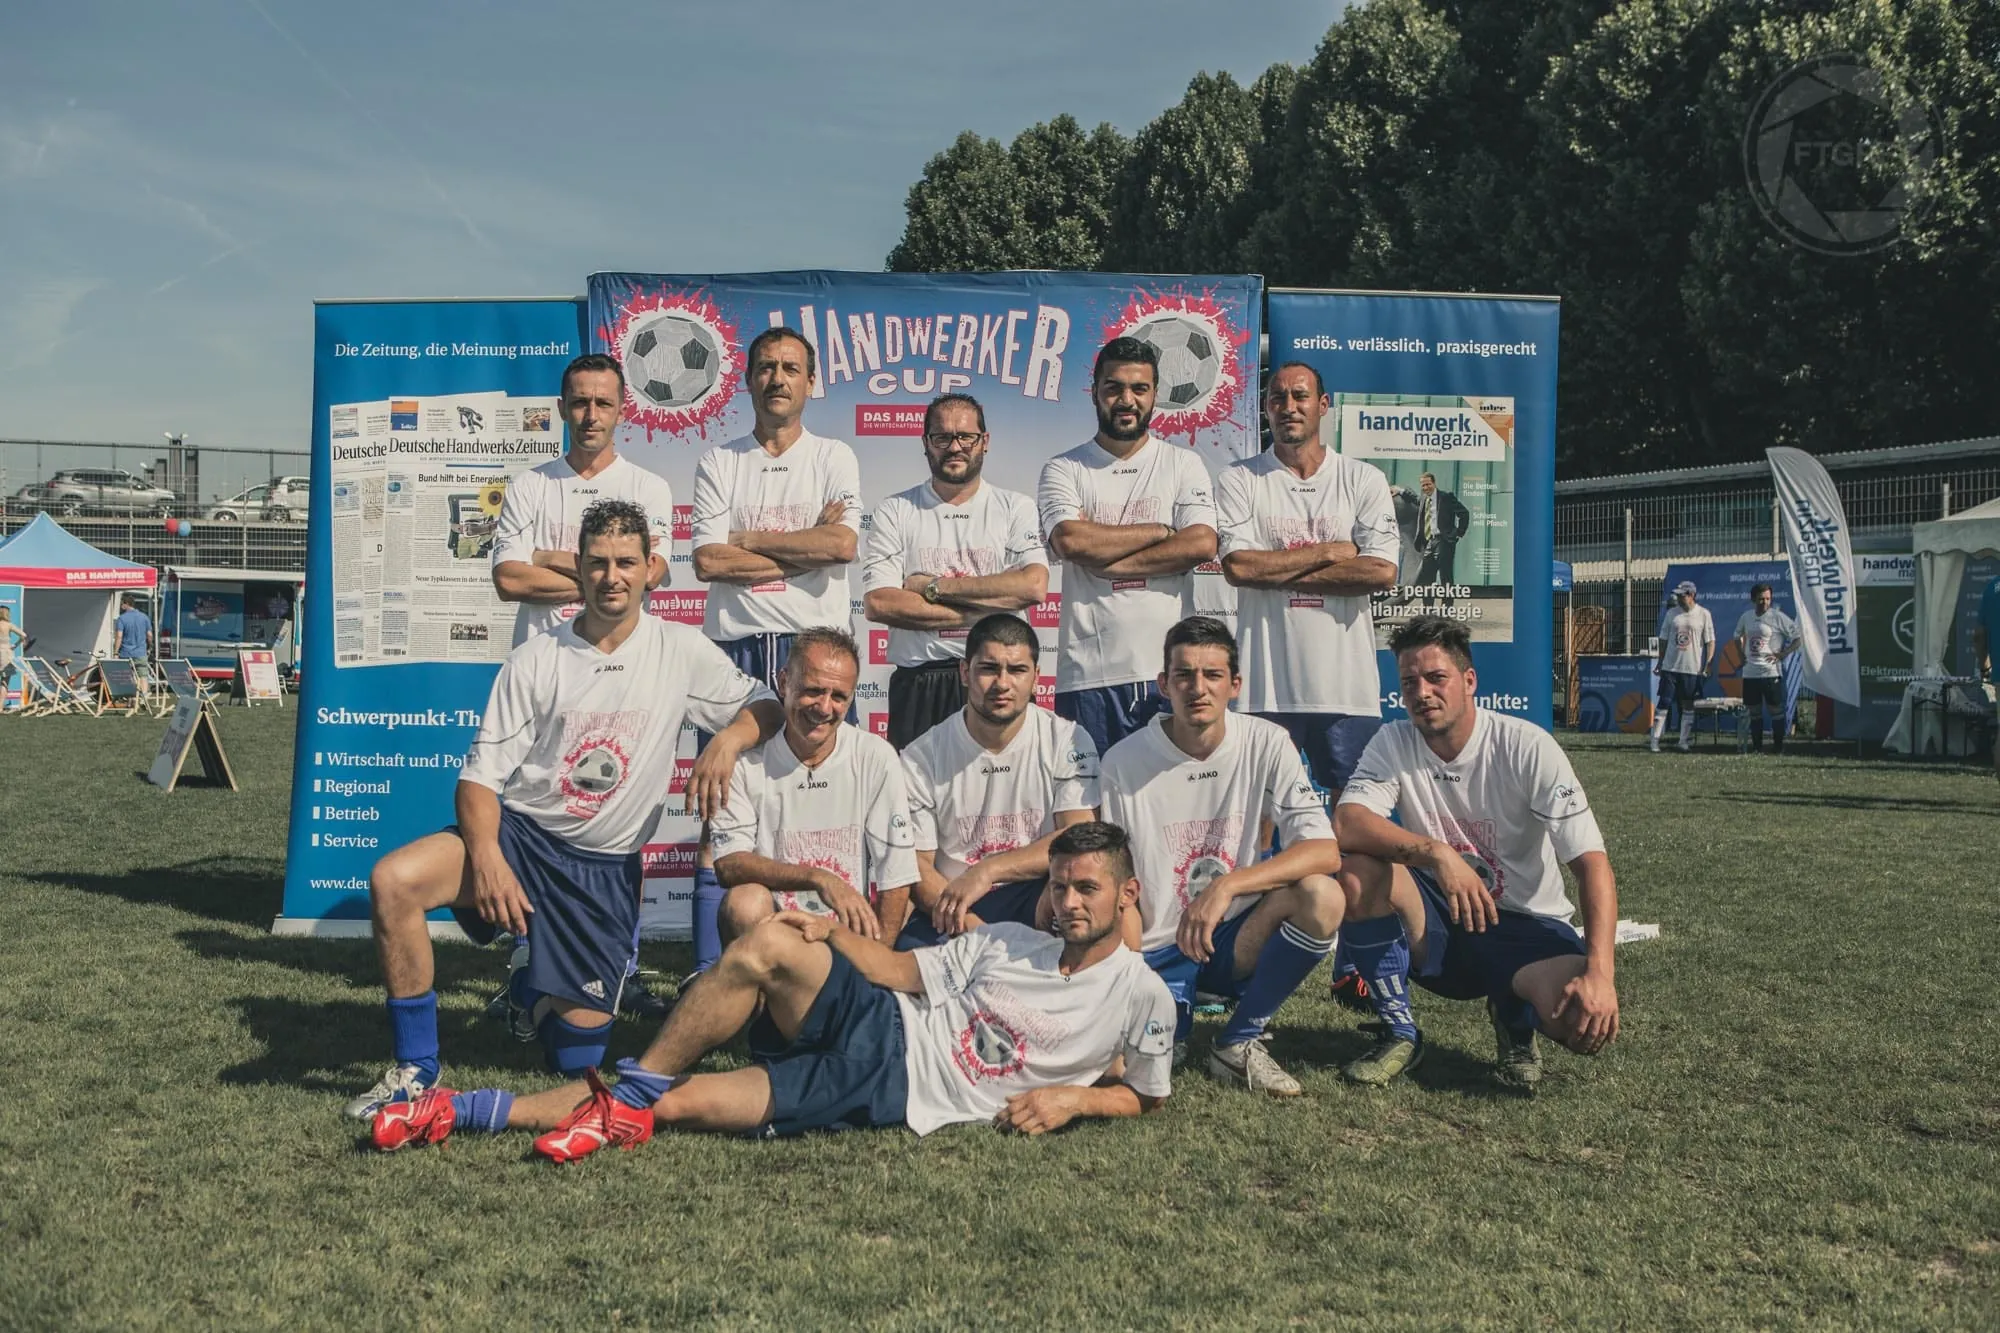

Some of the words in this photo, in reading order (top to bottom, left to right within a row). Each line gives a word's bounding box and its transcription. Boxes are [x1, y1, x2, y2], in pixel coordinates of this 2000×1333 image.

[335, 343, 359, 357] Die
[362, 343, 421, 359] Zeitung,
[425, 342, 448, 357] die
[451, 342, 517, 359] Meinung
[520, 342, 570, 356] macht!
[1293, 335, 1343, 350] seriös.
[1348, 337, 1431, 353] verlässlich.
[1436, 340, 1537, 357] praxisgerecht
[868, 367, 971, 395] CUP
[863, 412, 891, 422] DAS
[1359, 411, 1471, 433] handwerk
[1414, 429, 1489, 450] magazin
[332, 441, 388, 461] Deutsche
[418, 473, 438, 482] Bund
[440, 473, 454, 482] hilft
[456, 473, 468, 482] bei
[1404, 582, 1472, 600] perfekte
[1371, 601, 1482, 621] ilanzstrategie
[603, 664, 624, 672] JAKO
[317, 707, 482, 730] Schwerpunkt-Th
[327, 752, 405, 768] Wirtschaft
[409, 753, 440, 768] und
[990, 765, 1011, 774] JAKO
[1197, 770, 1218, 780] JAKO
[325, 779, 391, 795] Regional
[807, 781, 828, 789] JAKO
[325, 806, 380, 821] Betrieb
[323, 834, 378, 848] Service
